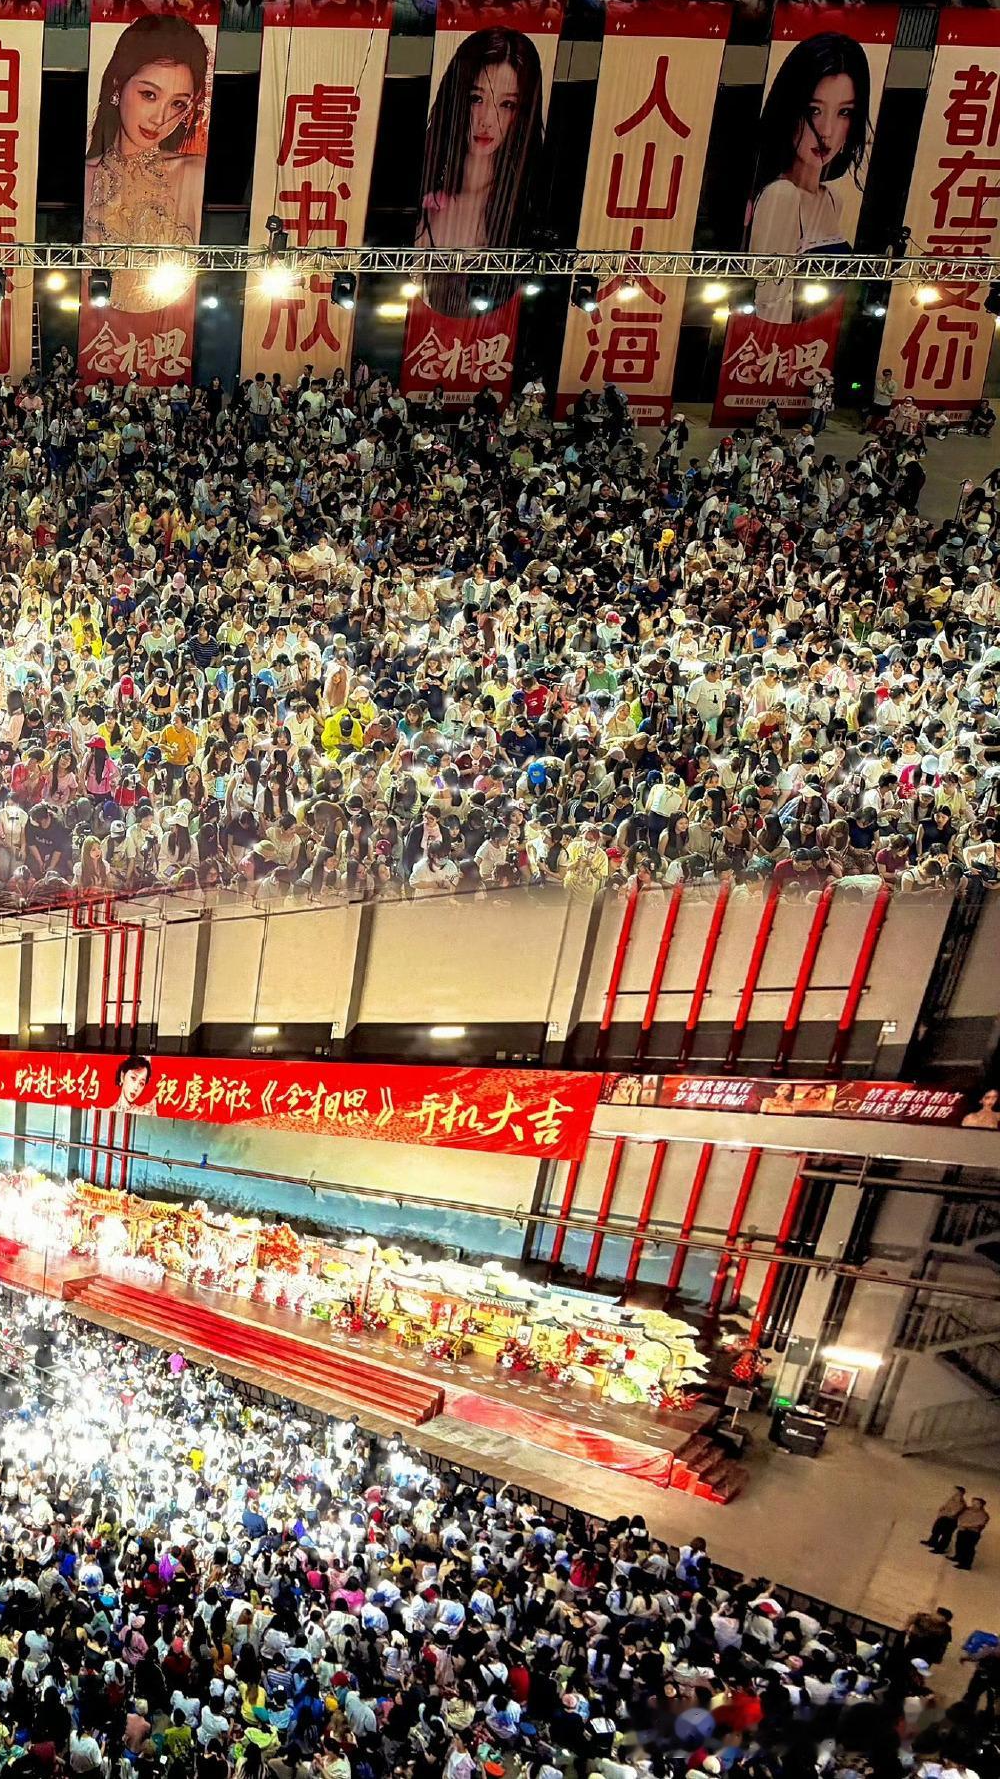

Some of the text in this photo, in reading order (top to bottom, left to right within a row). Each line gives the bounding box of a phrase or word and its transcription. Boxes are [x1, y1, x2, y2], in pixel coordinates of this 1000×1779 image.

[80, 321, 192, 380] 念相思
[405, 326, 513, 383] 念相思
[723, 332, 831, 387] 念相思
